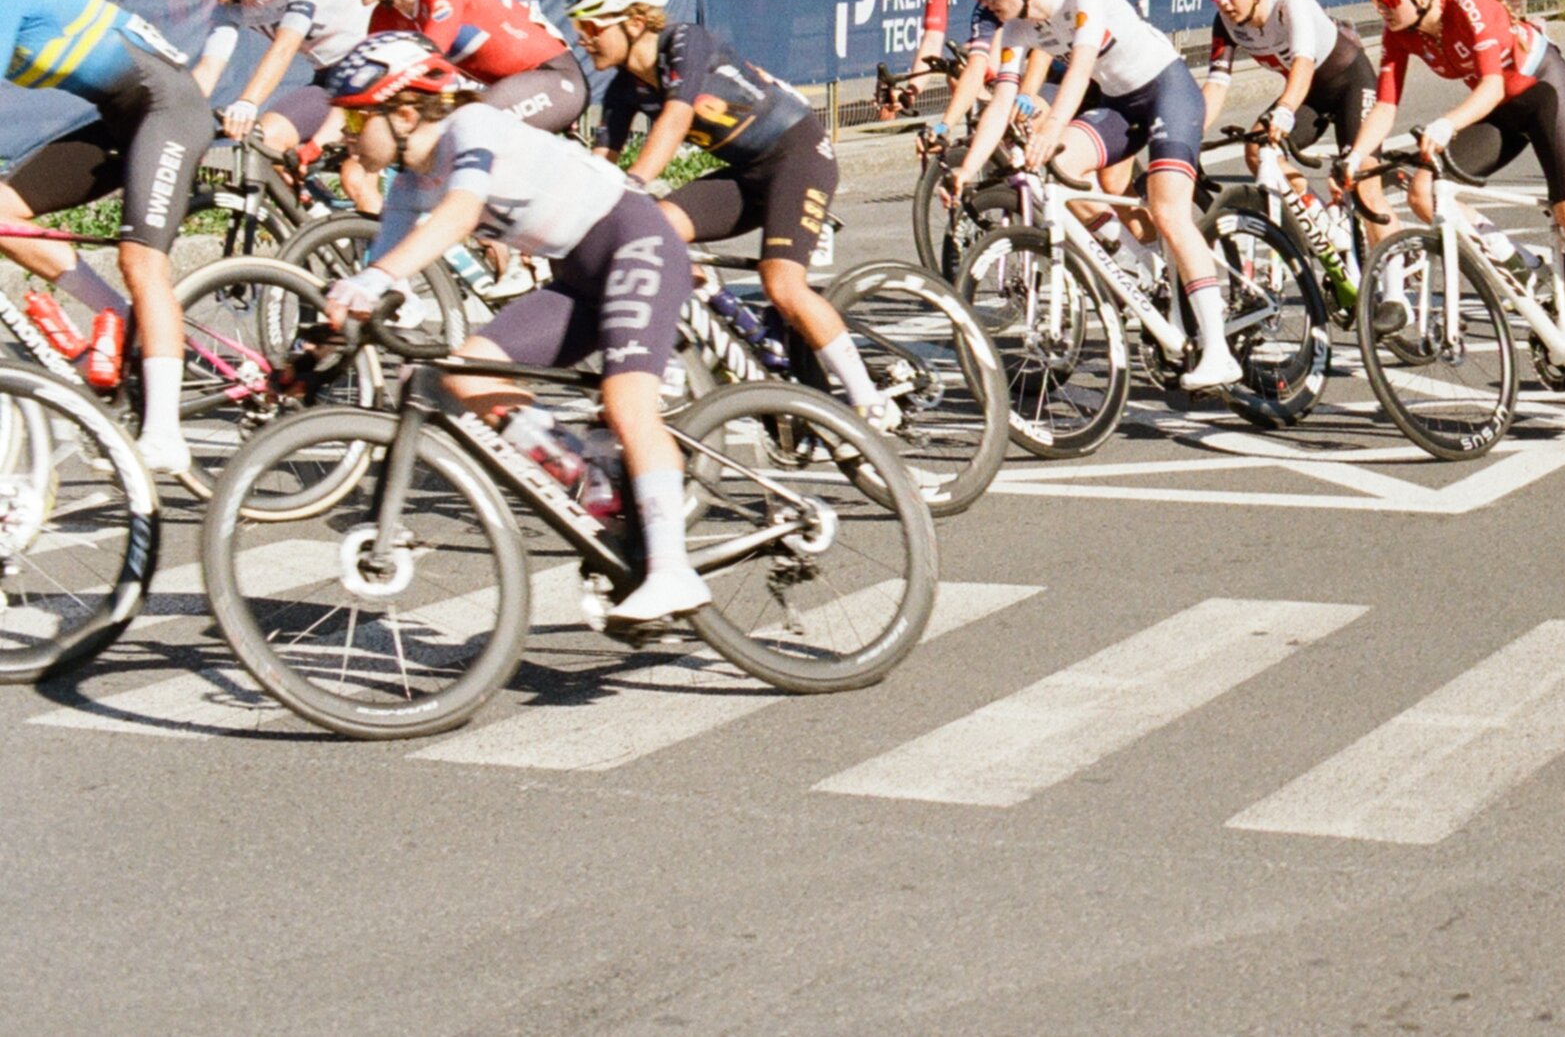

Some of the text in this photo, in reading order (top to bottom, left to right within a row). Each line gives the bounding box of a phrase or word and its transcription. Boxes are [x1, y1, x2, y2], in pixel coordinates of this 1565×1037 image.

[145, 140, 187, 229] SWEDEN
[603, 235, 665, 330] USA
[1089, 239, 1151, 312] COLNAGO
